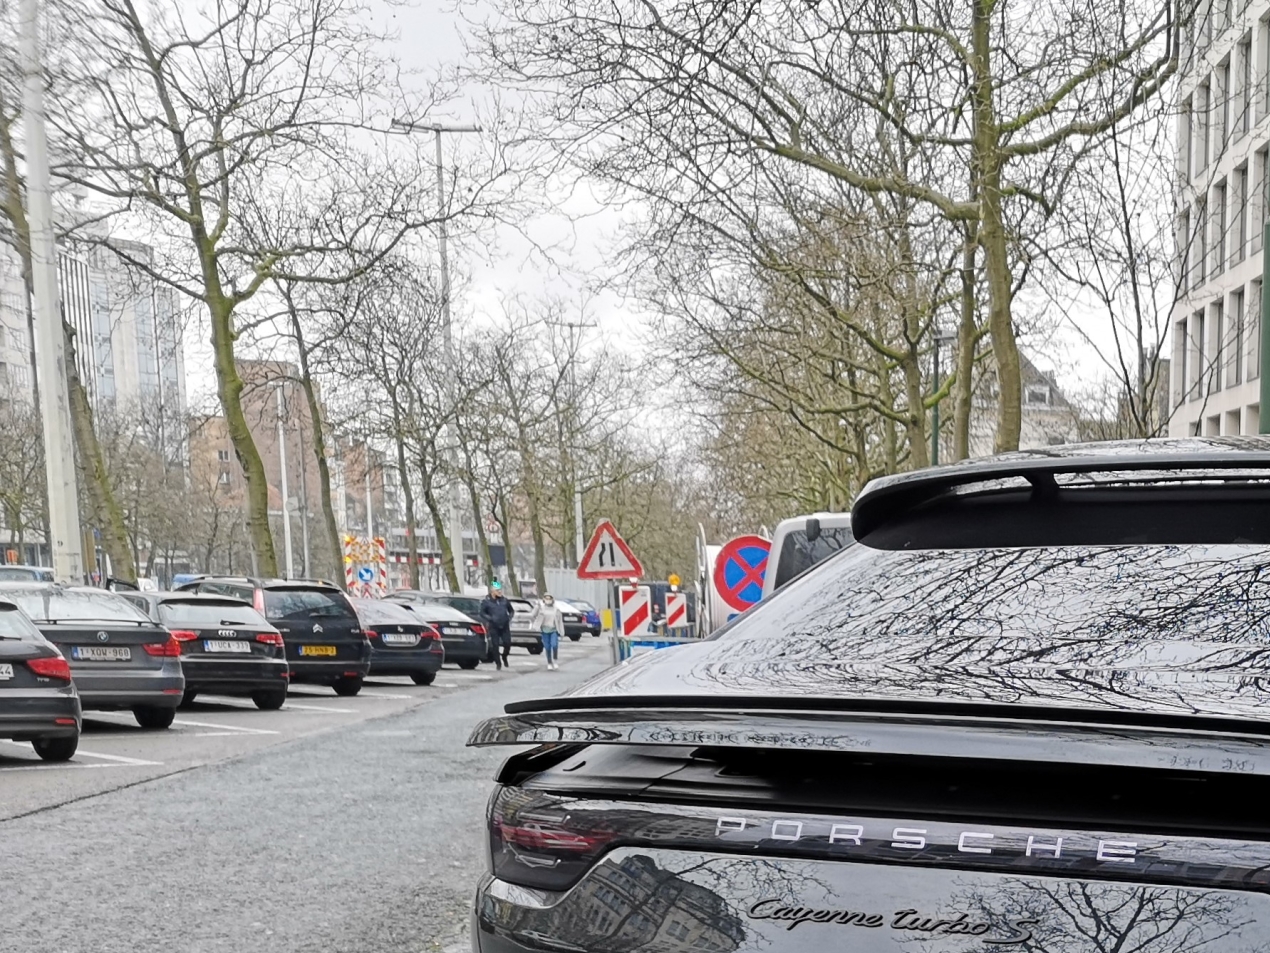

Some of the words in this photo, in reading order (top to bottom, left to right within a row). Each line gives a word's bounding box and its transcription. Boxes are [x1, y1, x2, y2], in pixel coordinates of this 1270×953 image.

[714, 816, 1138, 863] PORSCHE
[747, 898, 885, 930] Cayenne
[891, 907, 992, 935] turbo
[983, 917, 1039, 944] S
